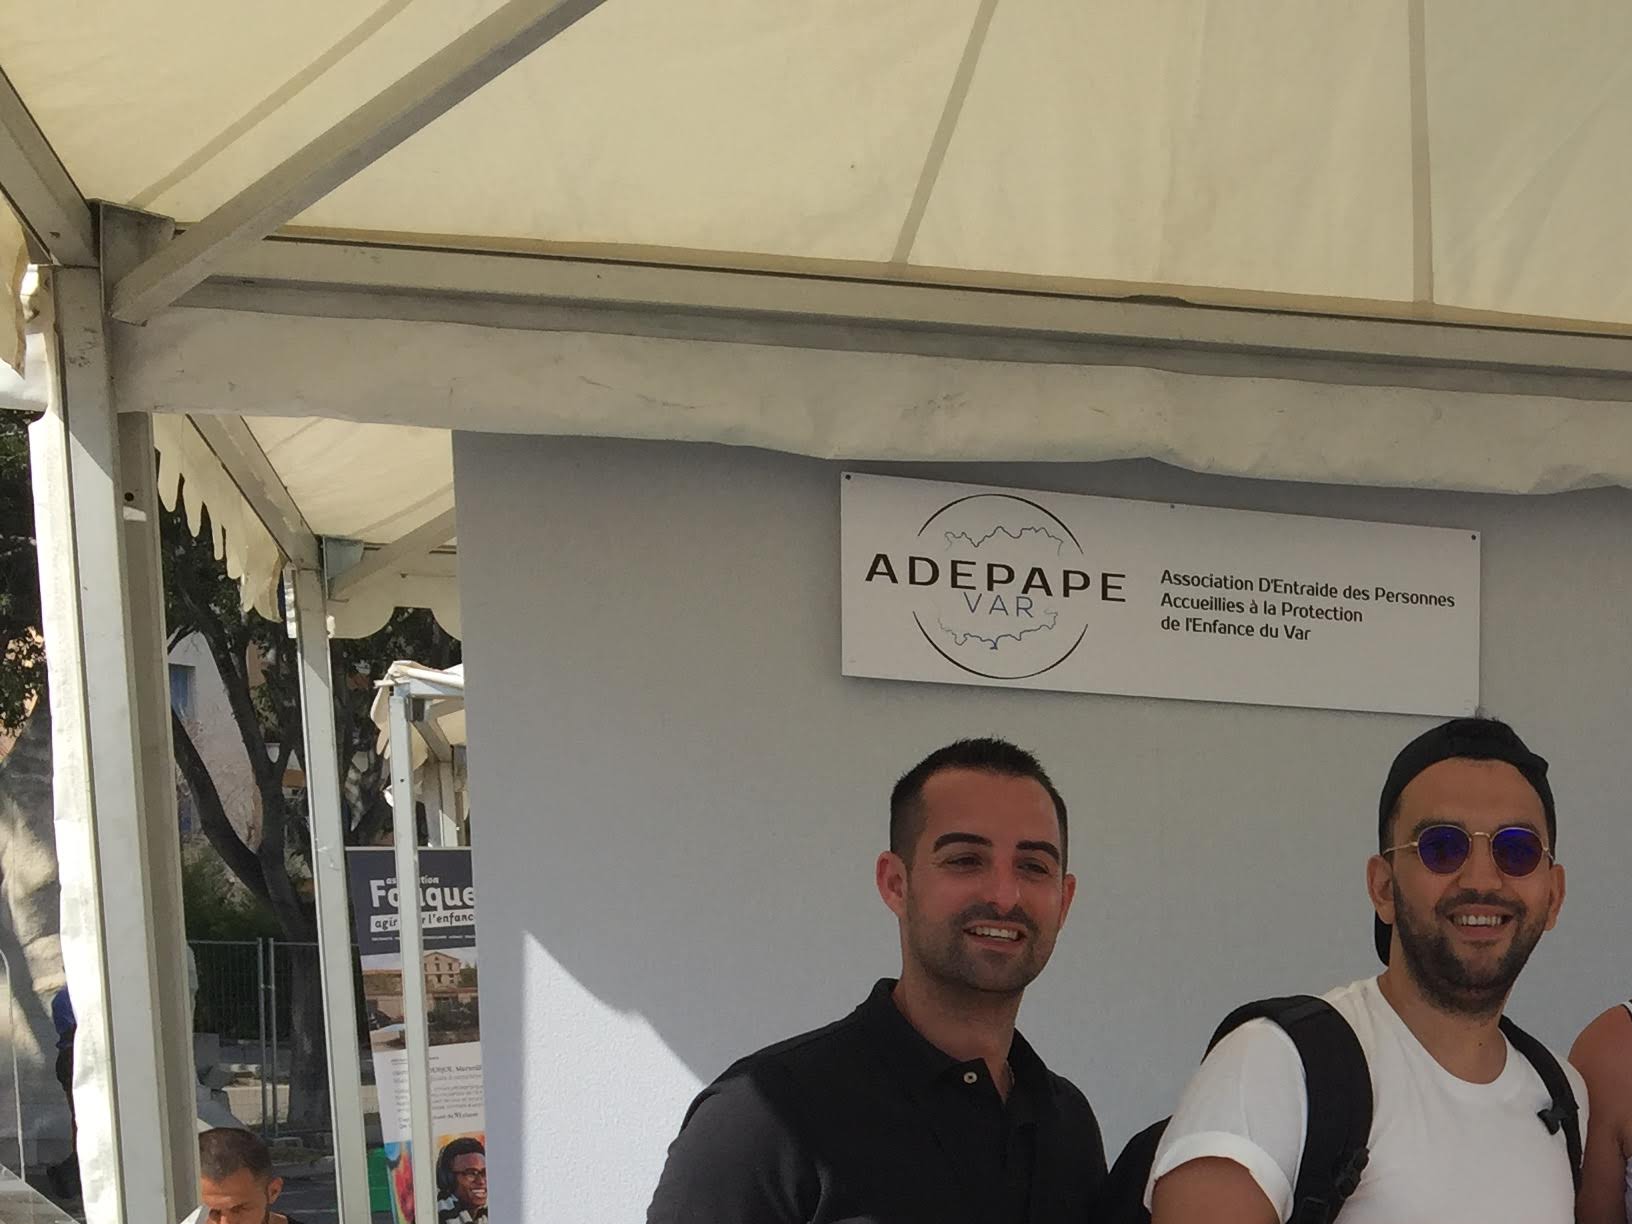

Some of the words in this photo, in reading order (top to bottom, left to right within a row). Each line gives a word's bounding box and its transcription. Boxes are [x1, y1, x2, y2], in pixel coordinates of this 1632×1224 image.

[865, 553, 1126, 602] ADEPAPE
[1160, 569, 1254, 591] Association
[1258, 577, 1338, 598] D'Entraide
[1342, 585, 1370, 601] des
[1374, 587, 1456, 608] Personnes
[963, 591, 1034, 618] VAR
[1160, 592, 1245, 614] Accueillies
[1249, 599, 1258, 614] à
[1263, 601, 1277, 616] la
[1281, 602, 1363, 622] Protection
[1161, 616, 1180, 631] de
[1185, 617, 1255, 637] l'Enfance
[1259, 623, 1279, 638] du
[1283, 624, 1312, 641] Var
[369, 879, 475, 911] Foque
[374, 917, 398, 931] agir
[428, 913, 474, 925] l'enfanc
